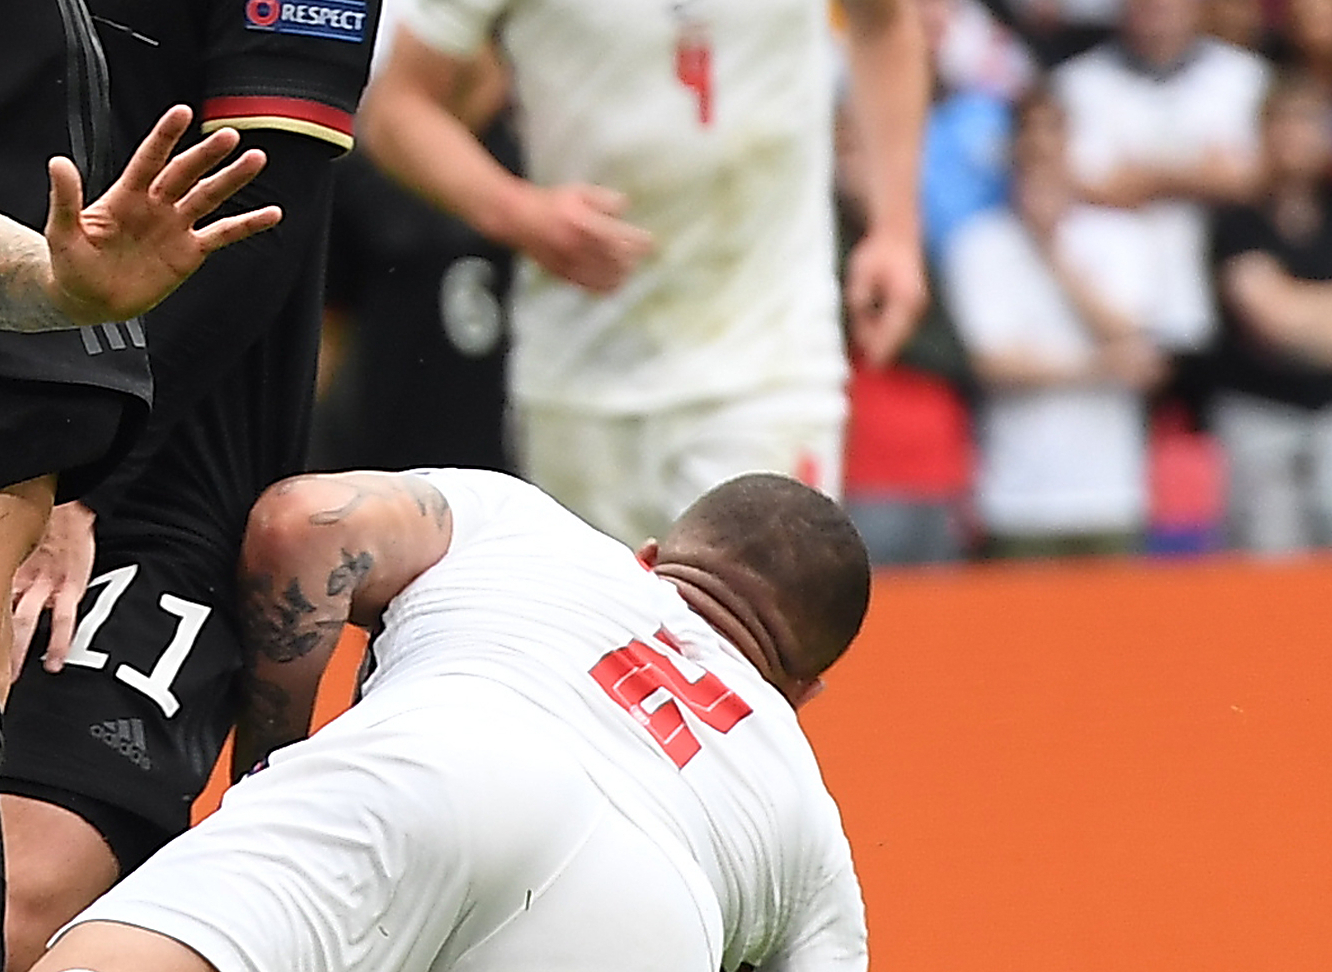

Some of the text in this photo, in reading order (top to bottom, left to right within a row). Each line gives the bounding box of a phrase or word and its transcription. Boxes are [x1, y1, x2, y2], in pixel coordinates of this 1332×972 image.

[281, 3, 367, 31] RESPECT
[675, 42, 714, 127] 4
[39, 564, 213, 718] 11
